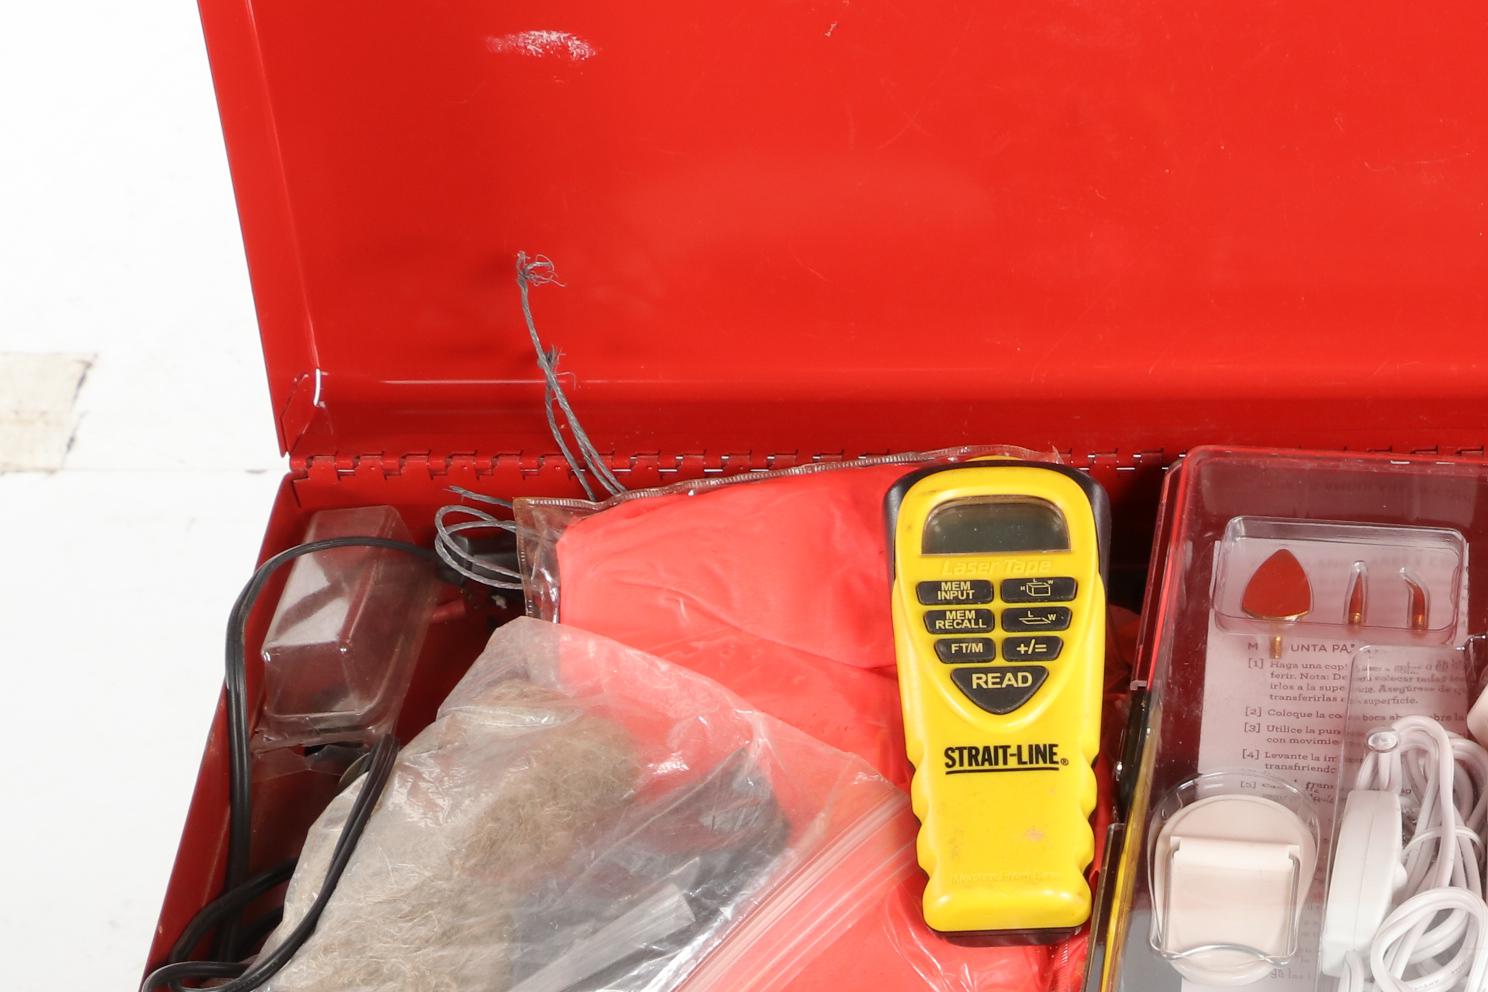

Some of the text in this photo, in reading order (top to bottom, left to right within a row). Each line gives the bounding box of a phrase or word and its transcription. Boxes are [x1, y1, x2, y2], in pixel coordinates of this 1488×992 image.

[941, 581, 971, 590] MEM
[937, 590, 976, 601] INPUT
[945, 610, 976, 621] MEM
[935, 619, 987, 630] RECALL
[950, 643, 983, 655] FT/M
[970, 672, 1033, 690] READ
